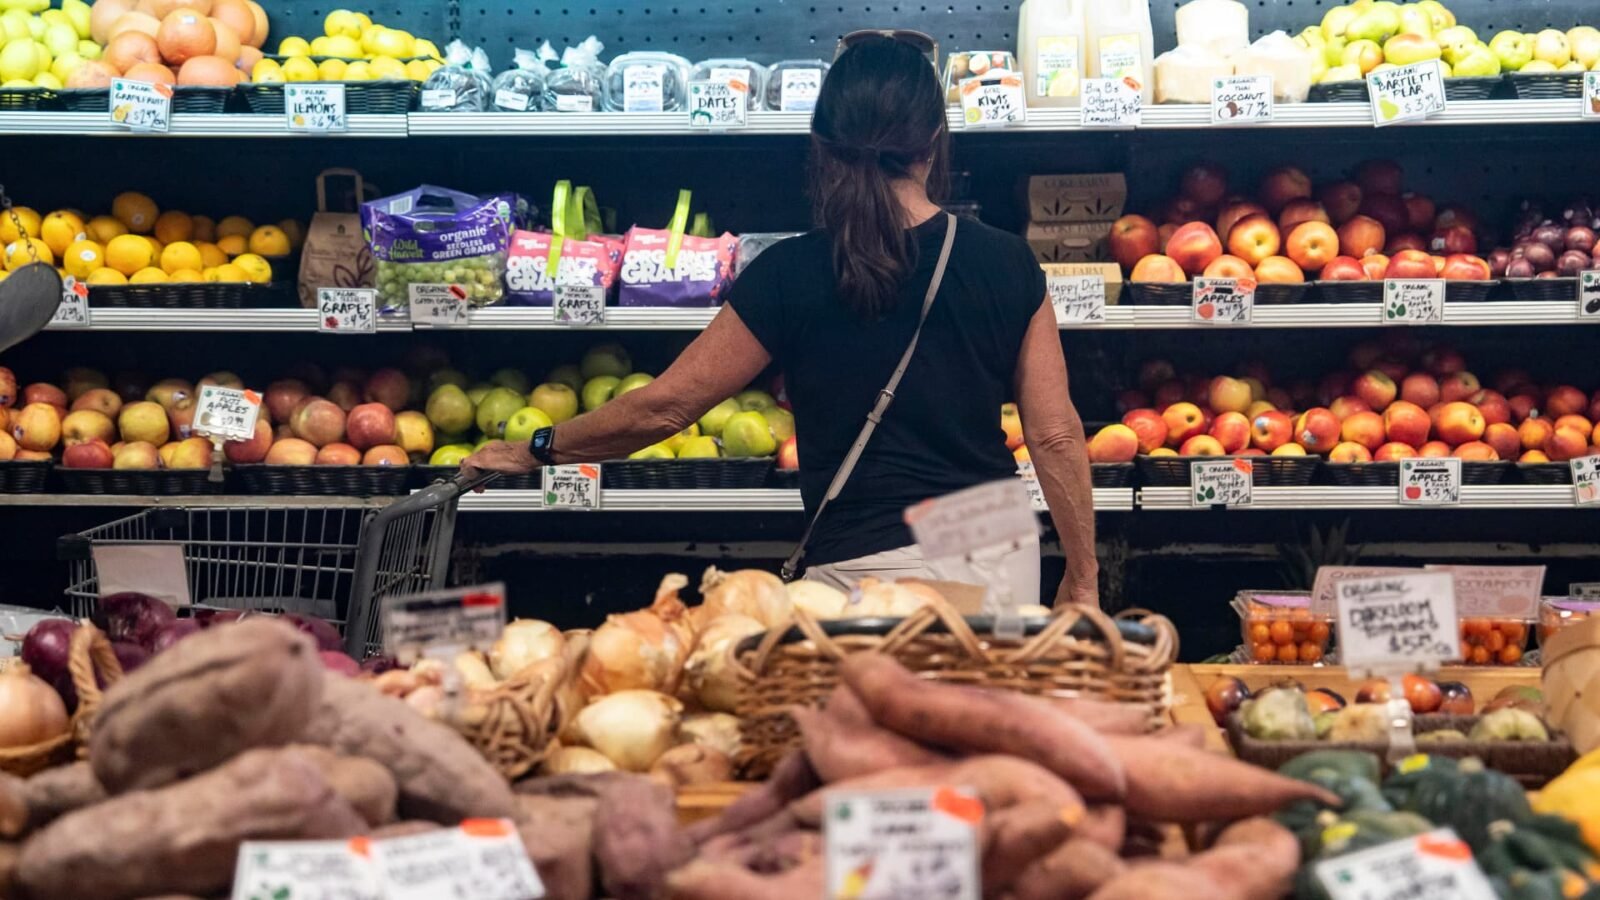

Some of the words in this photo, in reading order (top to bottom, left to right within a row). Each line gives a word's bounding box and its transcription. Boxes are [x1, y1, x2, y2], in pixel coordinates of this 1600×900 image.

[1378, 72, 1433, 91] BARTLETT
[1218, 92, 1266, 102] COCONUT
[1392, 85, 1424, 99] PEAR
[294, 102, 337, 114] LEMONS
[699, 97, 737, 108] DATES
[439, 224, 487, 243] organic
[432, 249, 463, 259] GREEN
[463, 243, 497, 256] GRAPES
[446, 239, 483, 251] SEEDLESS
[558, 299, 600, 310] GRAPES
[1198, 293, 1244, 304] APPLES
[322, 302, 371, 314] GRAPES
[206, 401, 249, 414] APPLES
[1409, 473, 1452, 483] APPLES
[552, 481, 590, 493] APPLES
